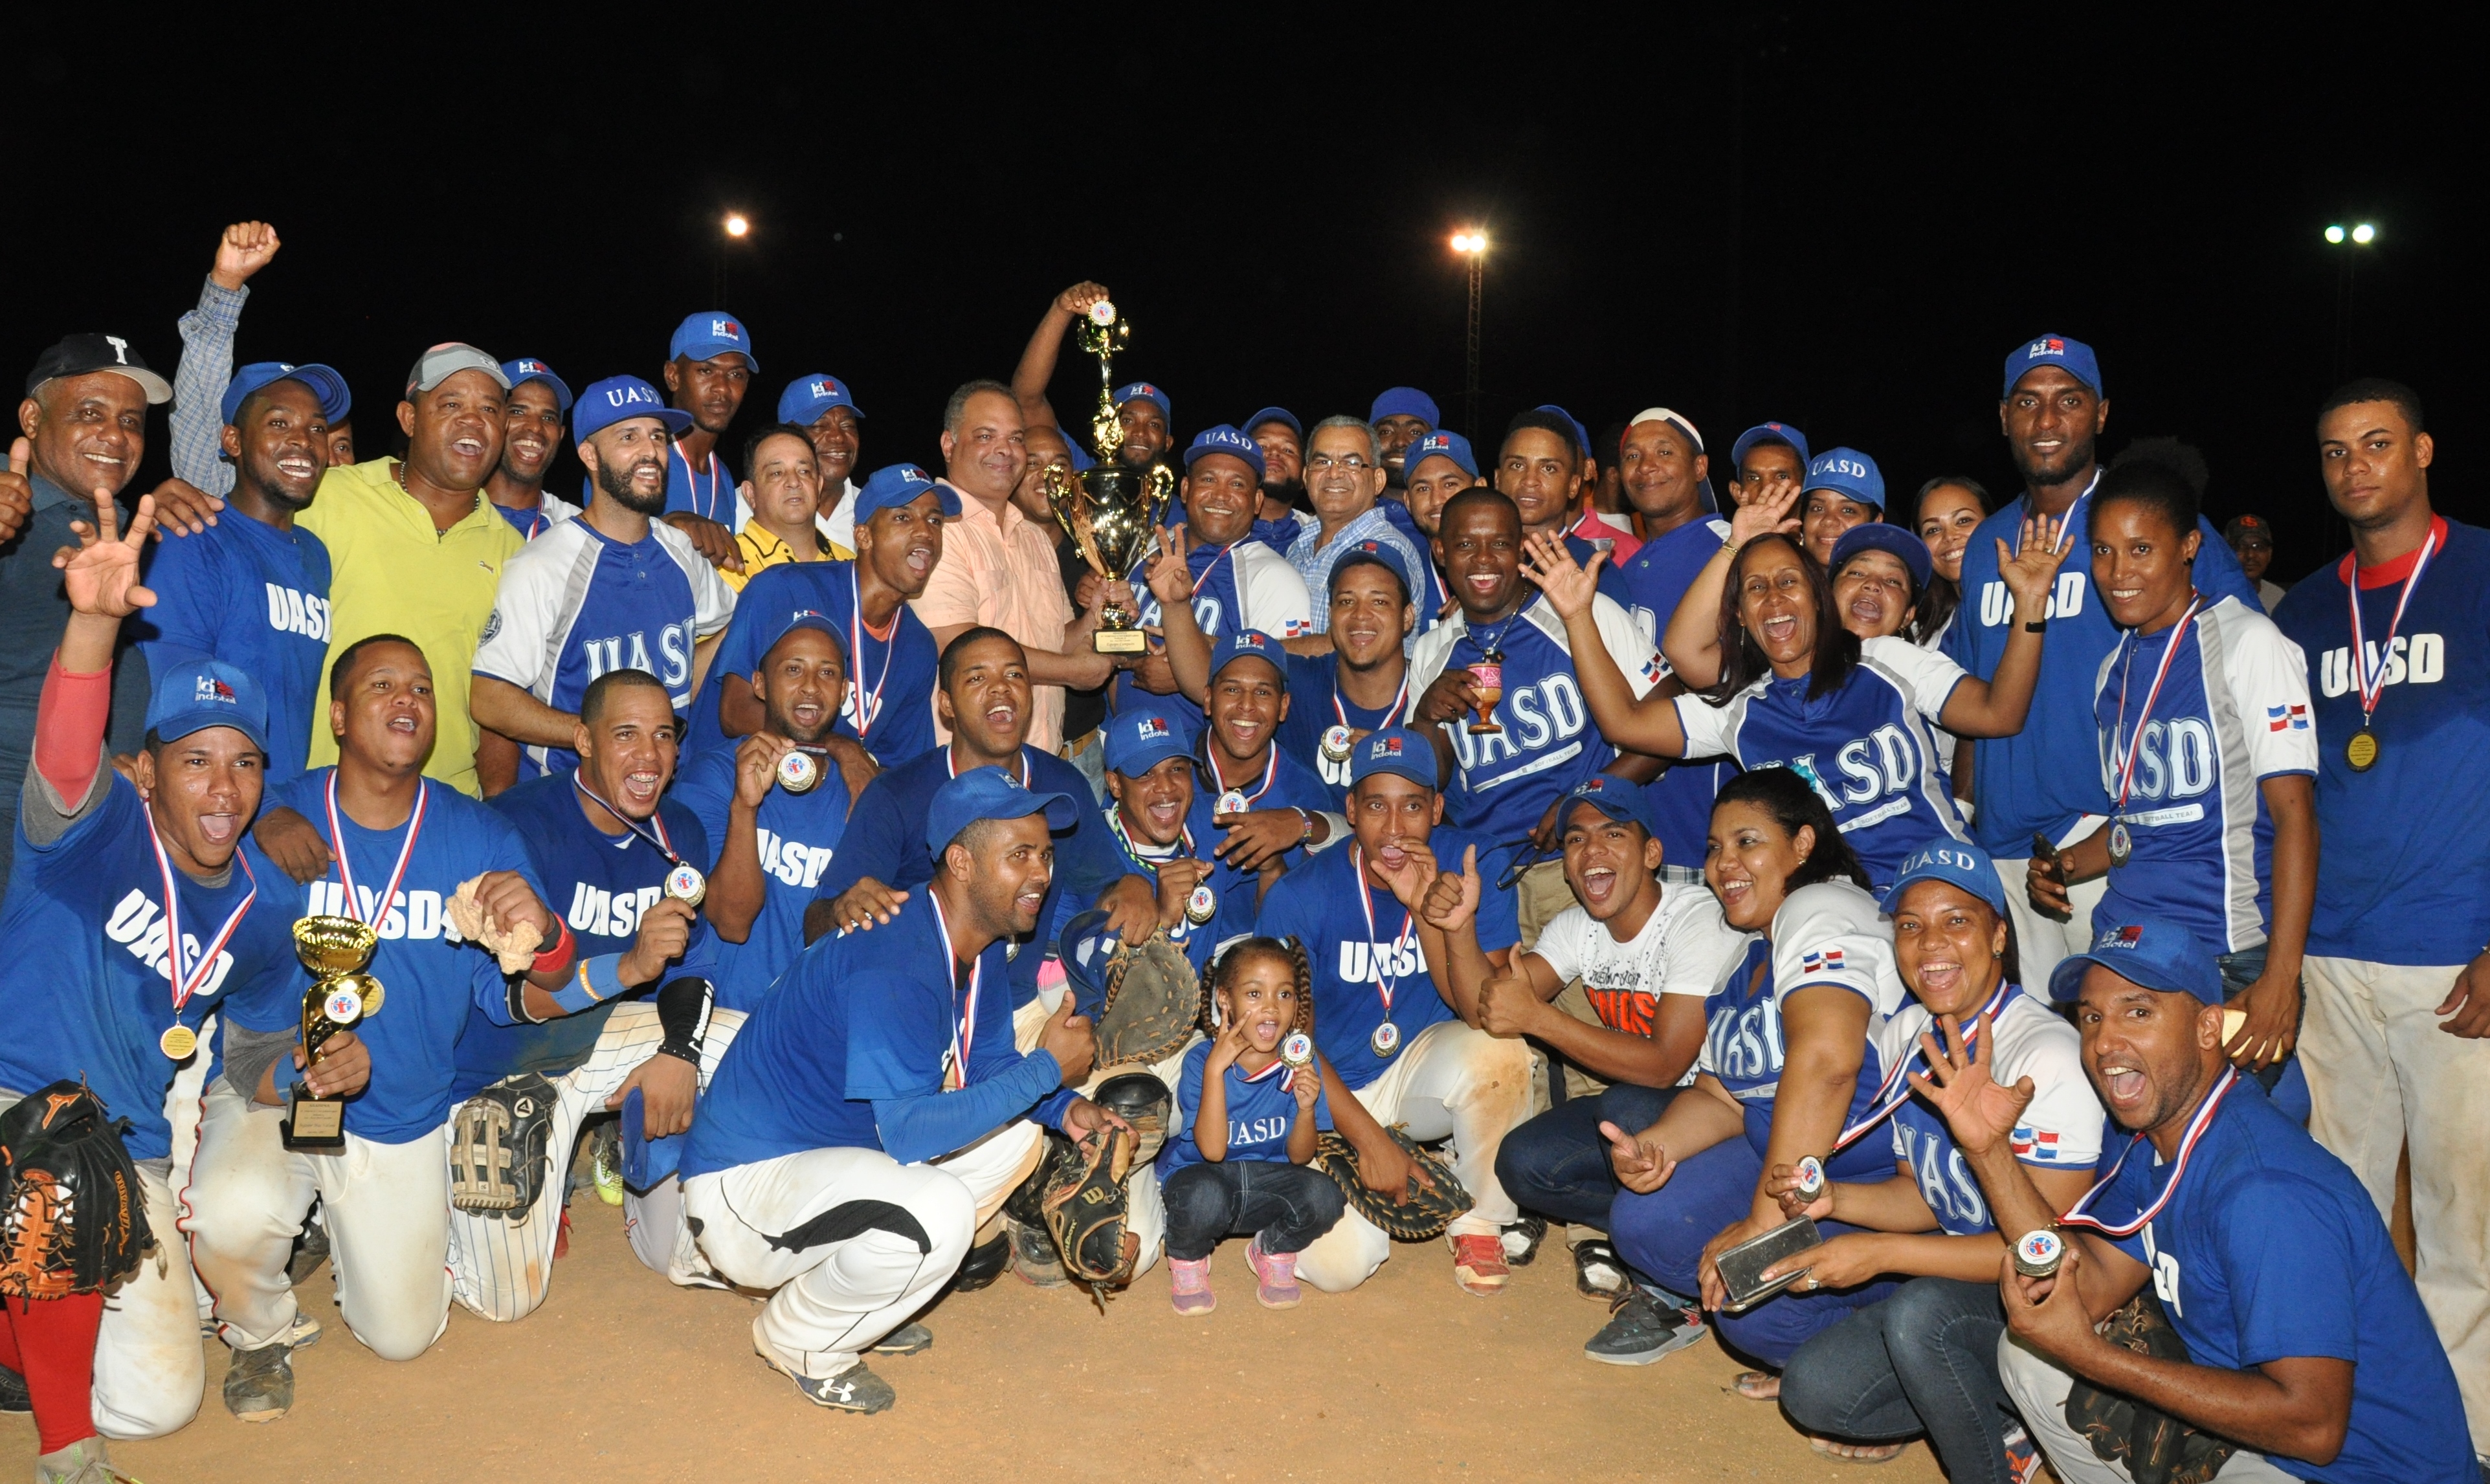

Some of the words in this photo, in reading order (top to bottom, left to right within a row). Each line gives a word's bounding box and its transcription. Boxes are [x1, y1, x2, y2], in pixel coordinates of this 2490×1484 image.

[106, 335, 128, 364] T
[2029, 349, 2063, 359] indotel
[606, 386, 660, 407] UASD
[1206, 431, 1252, 450] UASD
[1812, 459, 1866, 478] UASD
[195, 692, 237, 704] indotel
[1140, 730, 1170, 740] indotel
[1371, 749, 1402, 760] indotel
[1564, 746, 1578, 757] TEAM
[1902, 849, 1975, 875] UASD
